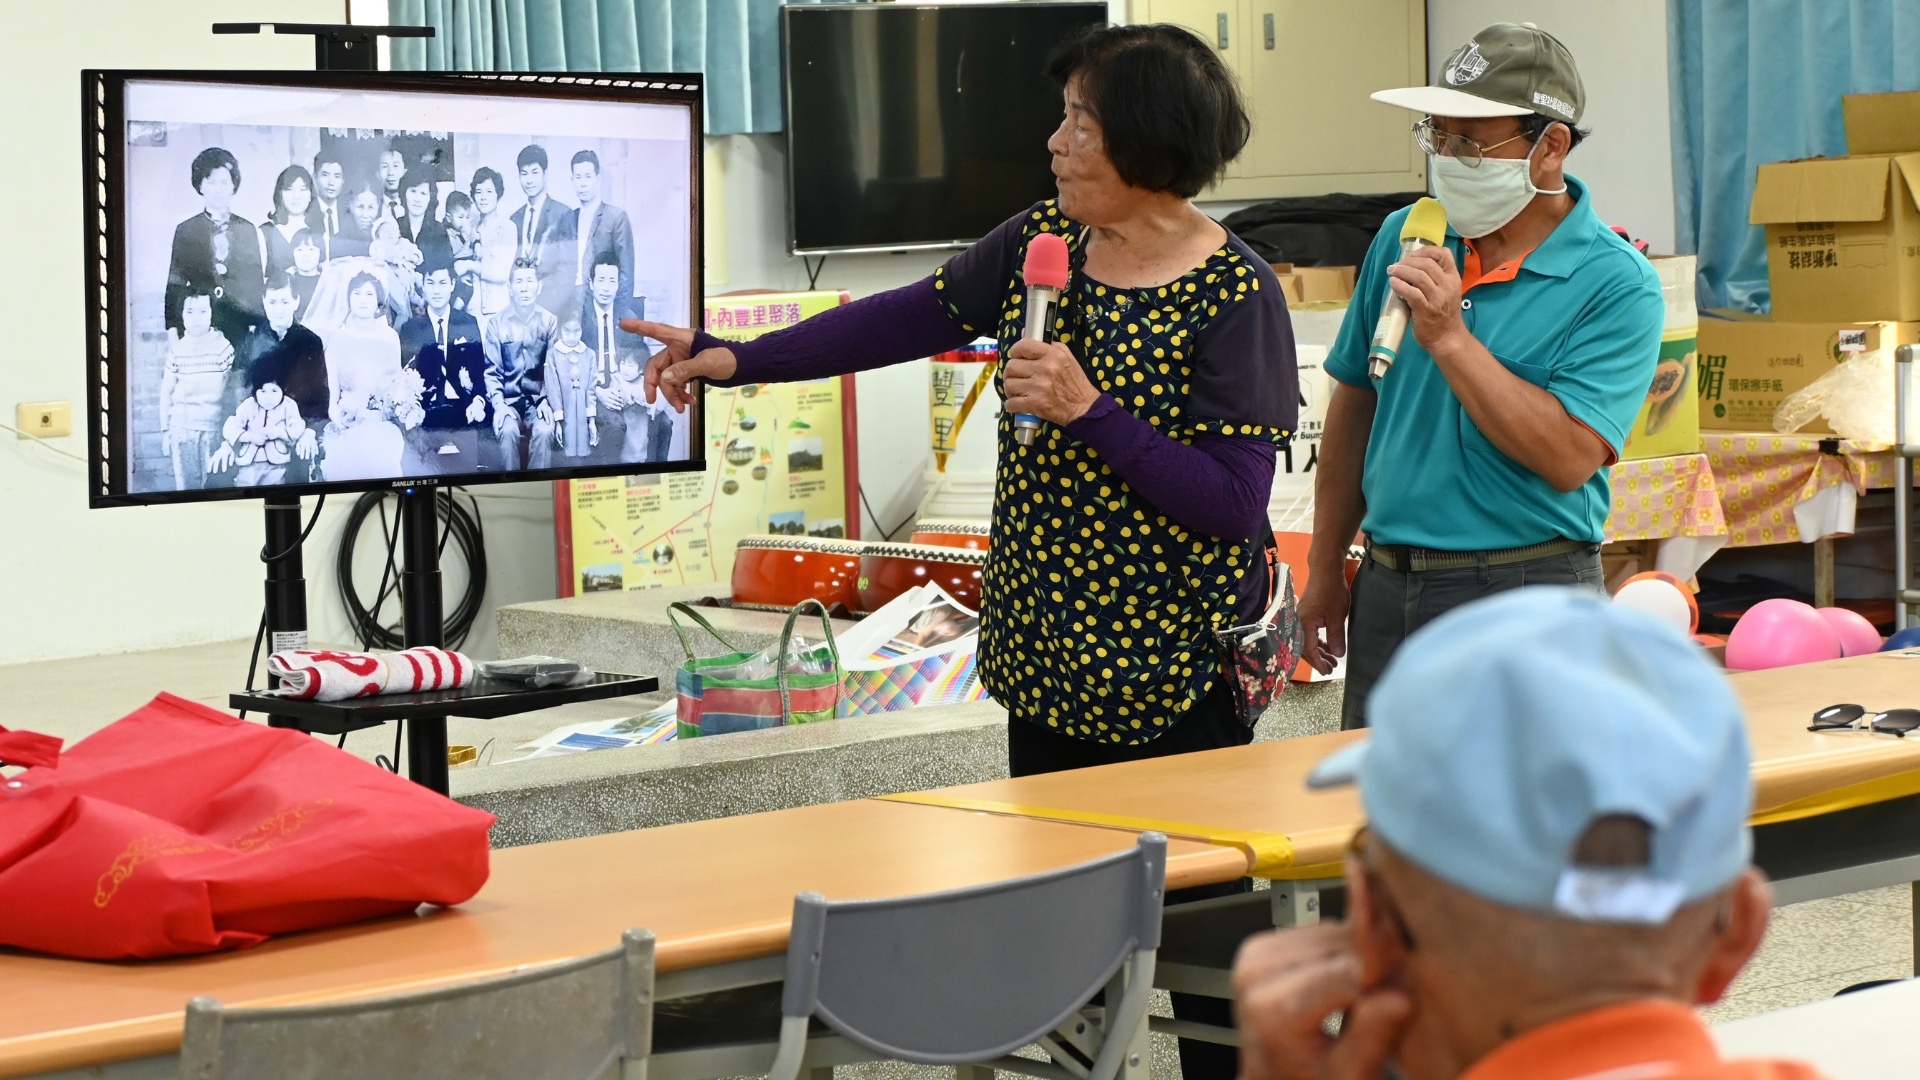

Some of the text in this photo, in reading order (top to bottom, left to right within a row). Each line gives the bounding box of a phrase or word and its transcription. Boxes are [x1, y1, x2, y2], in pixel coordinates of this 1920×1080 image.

[1729, 379, 1783, 392] 環保擦手紙
